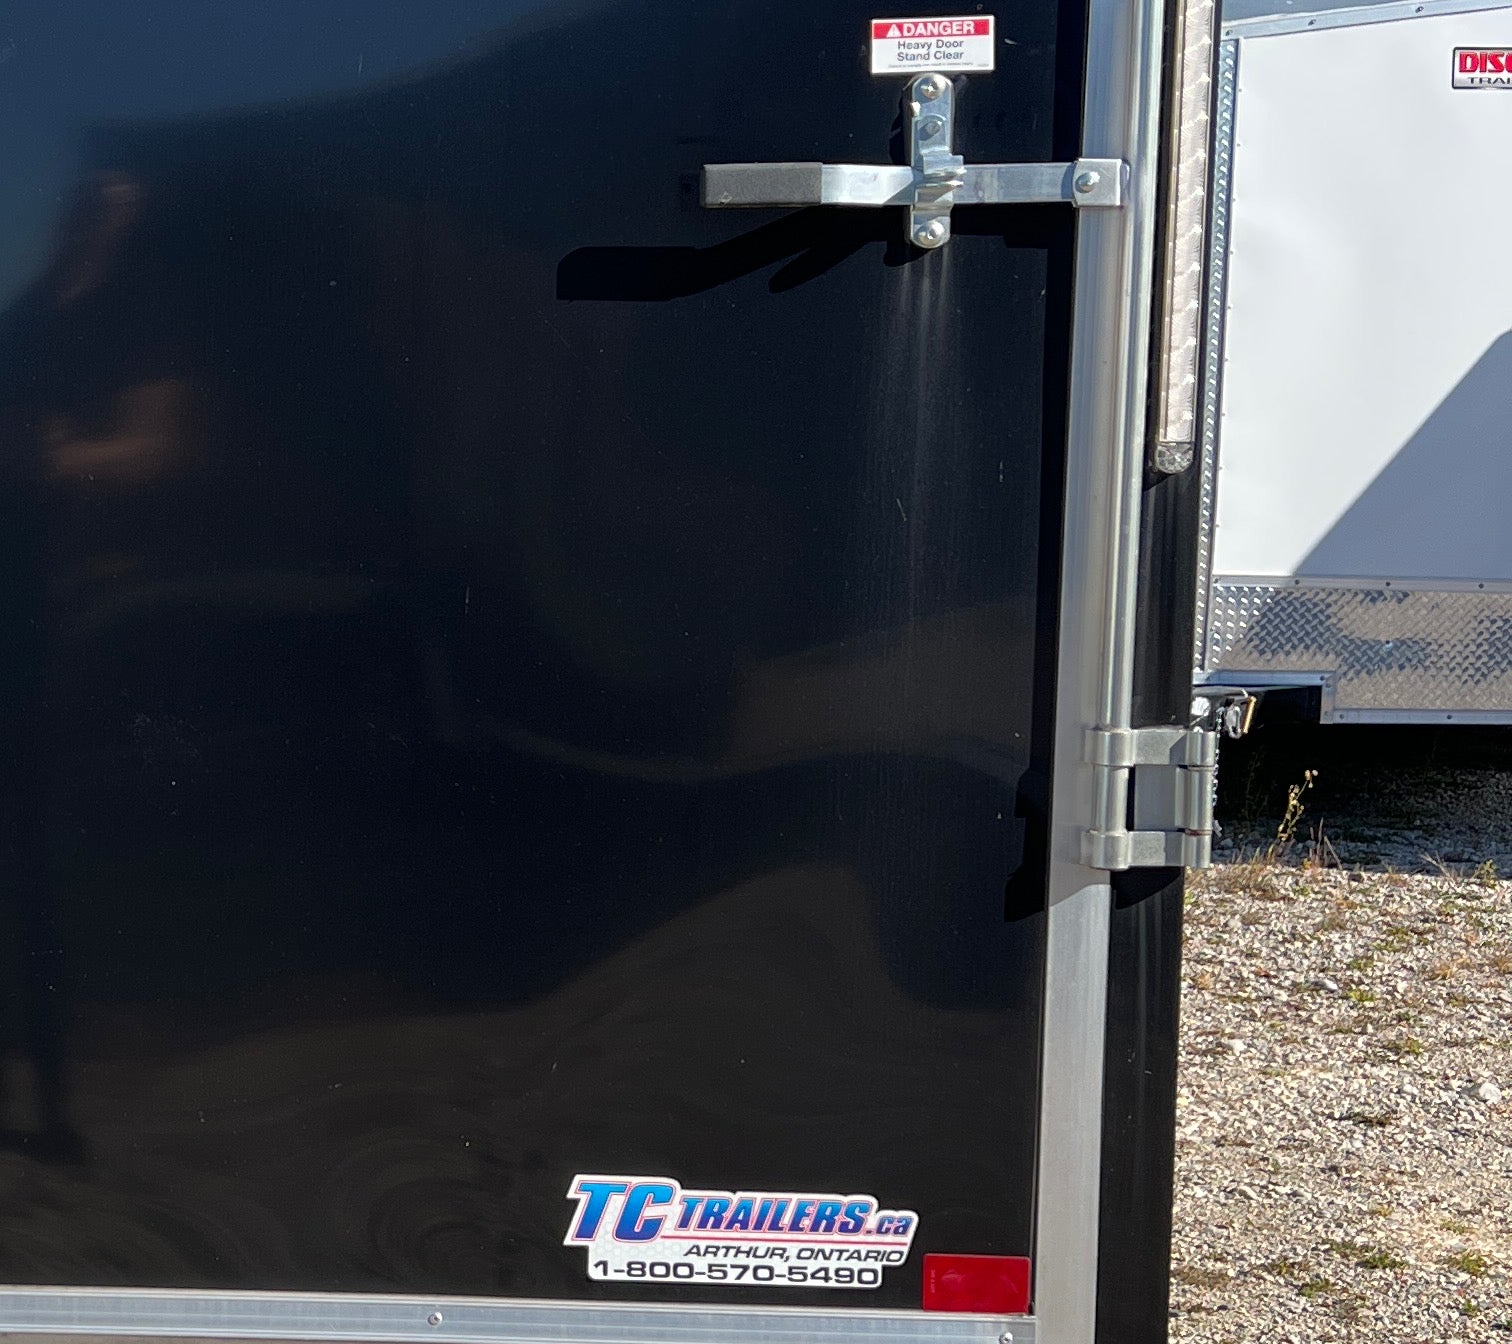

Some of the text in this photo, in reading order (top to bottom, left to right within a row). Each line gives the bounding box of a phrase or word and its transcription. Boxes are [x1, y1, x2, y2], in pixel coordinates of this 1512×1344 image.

[903, 20, 976, 37] DANGER
[897, 39, 965, 51] Heavy Door
[897, 50, 965, 62] Stand Clear
[571, 1179, 675, 1244] TC
[683, 1243, 906, 1263] ARTHUR, ONTARIO
[592, 1259, 880, 1286] 1-800-570-5490
